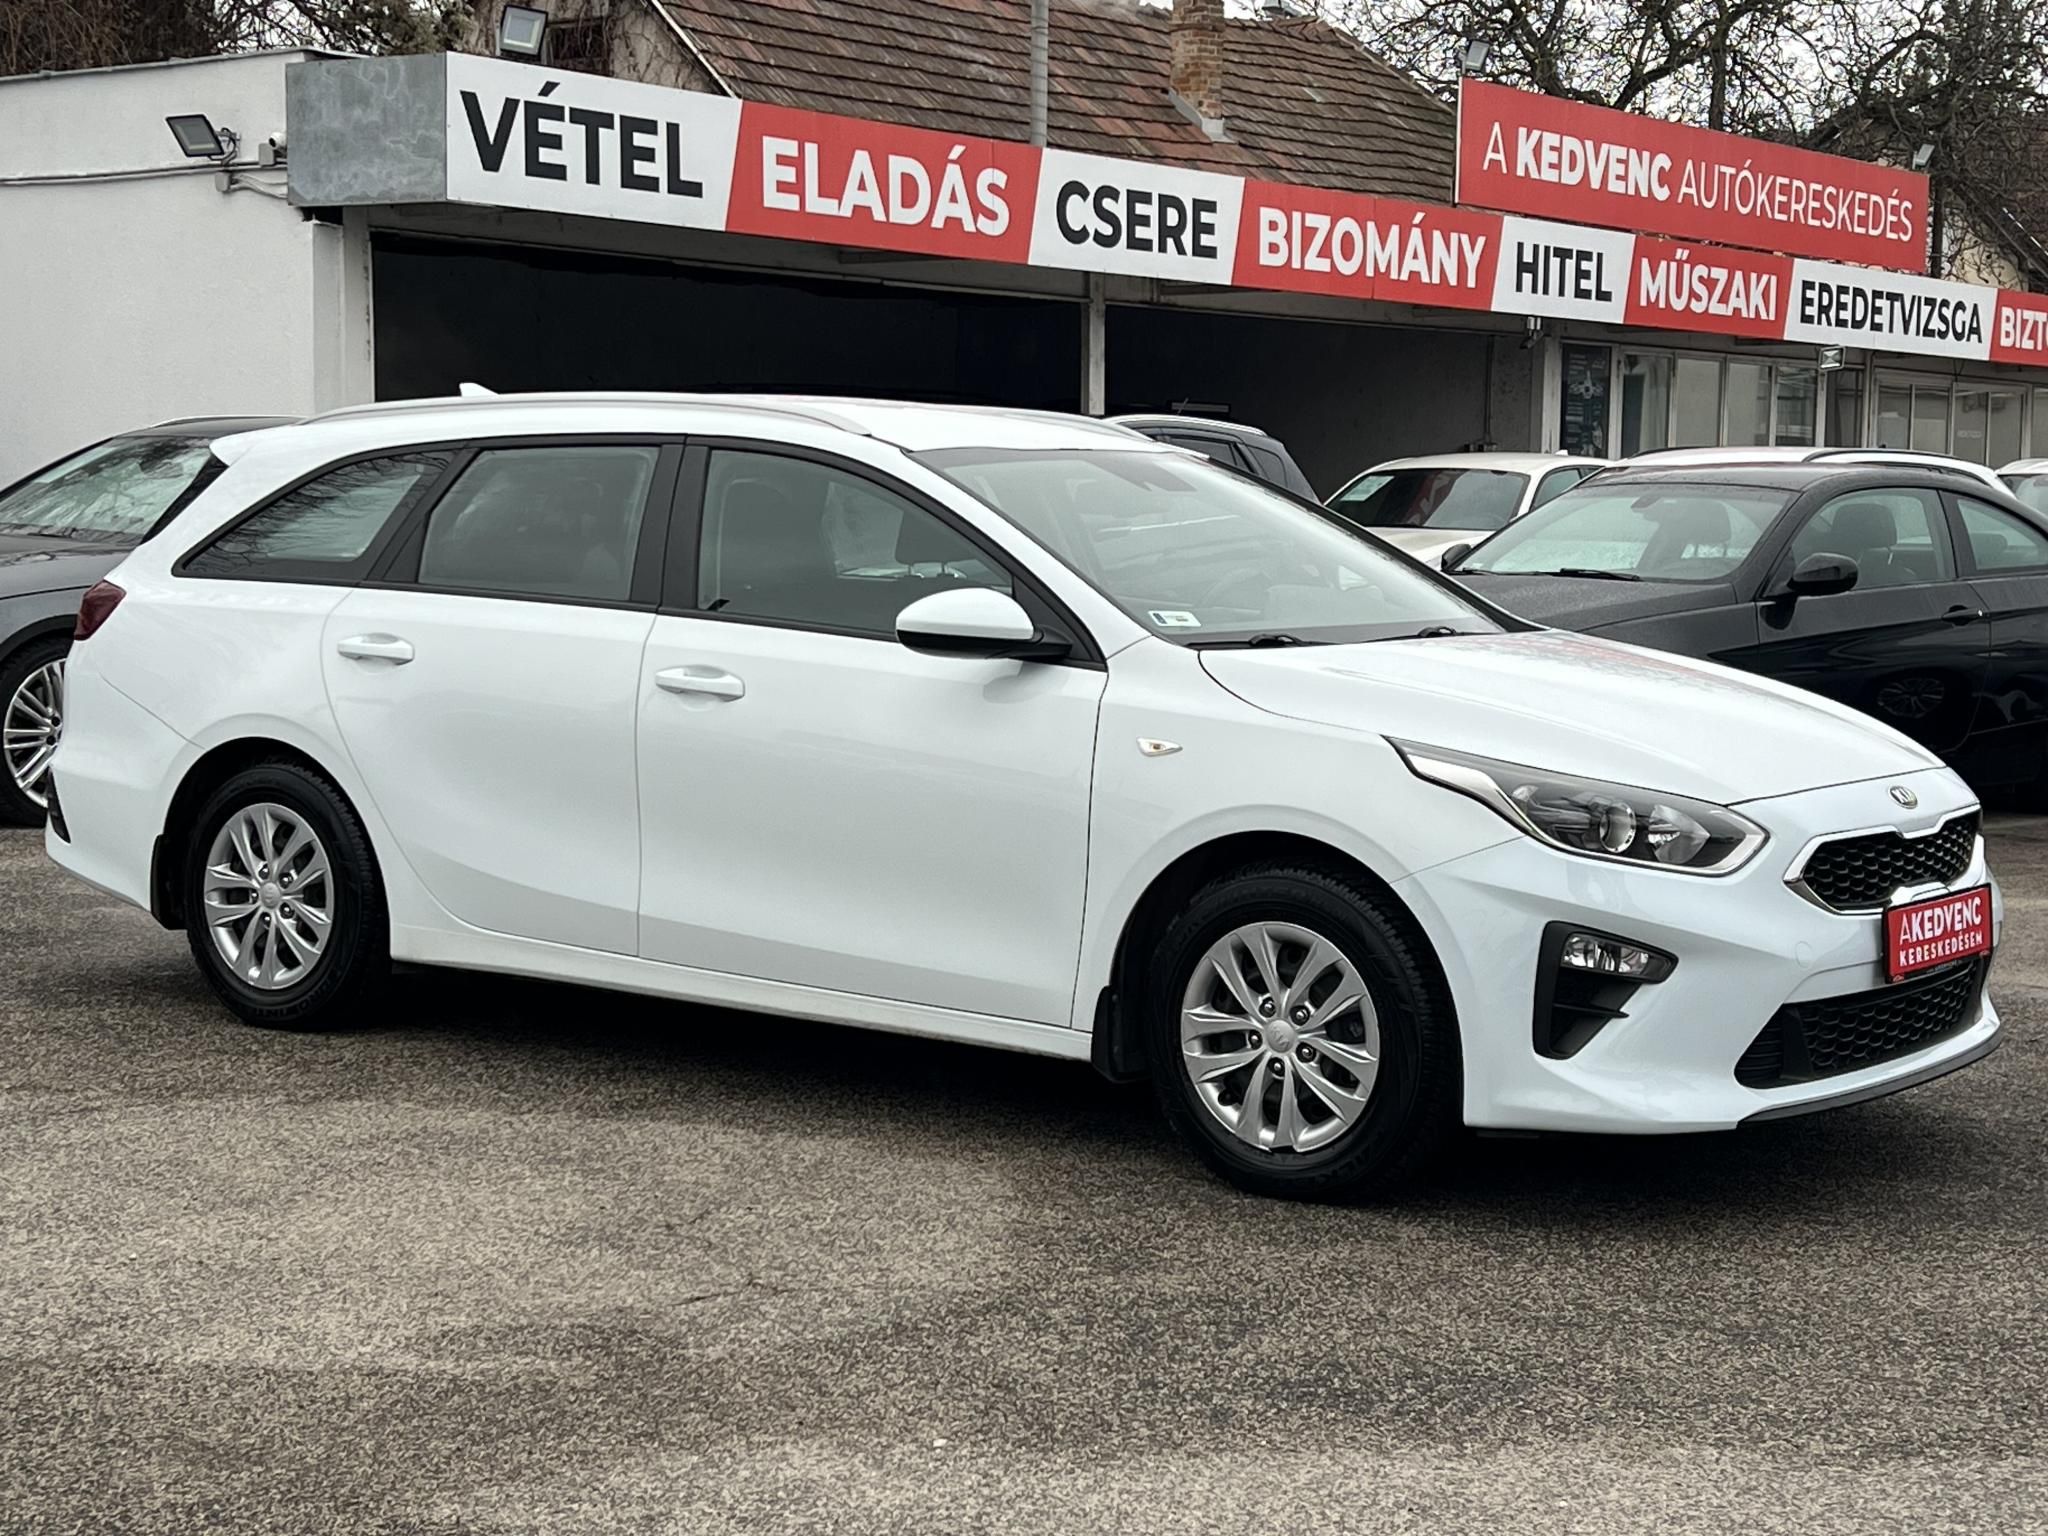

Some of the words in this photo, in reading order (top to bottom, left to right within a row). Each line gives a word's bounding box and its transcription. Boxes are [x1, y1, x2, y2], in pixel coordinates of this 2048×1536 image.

[459, 81, 703, 199] VÉTEL
[762, 135, 1011, 236] ELADÁS
[1056, 180, 1218, 260] CSERE
[1258, 206, 1487, 289] BIZOMÁNY
[1514, 240, 1613, 303] HITEL
[1640, 248, 1777, 321] MŰSZAKI
[1799, 279, 1984, 345] EREDETVIZSGA
[1999, 304, 2048, 353] BIZT
[1481, 120, 1509, 175] A
[1515, 125, 1672, 202] KEDVENC
[1677, 160, 1913, 243] AUTÓKERESKEDÉS
